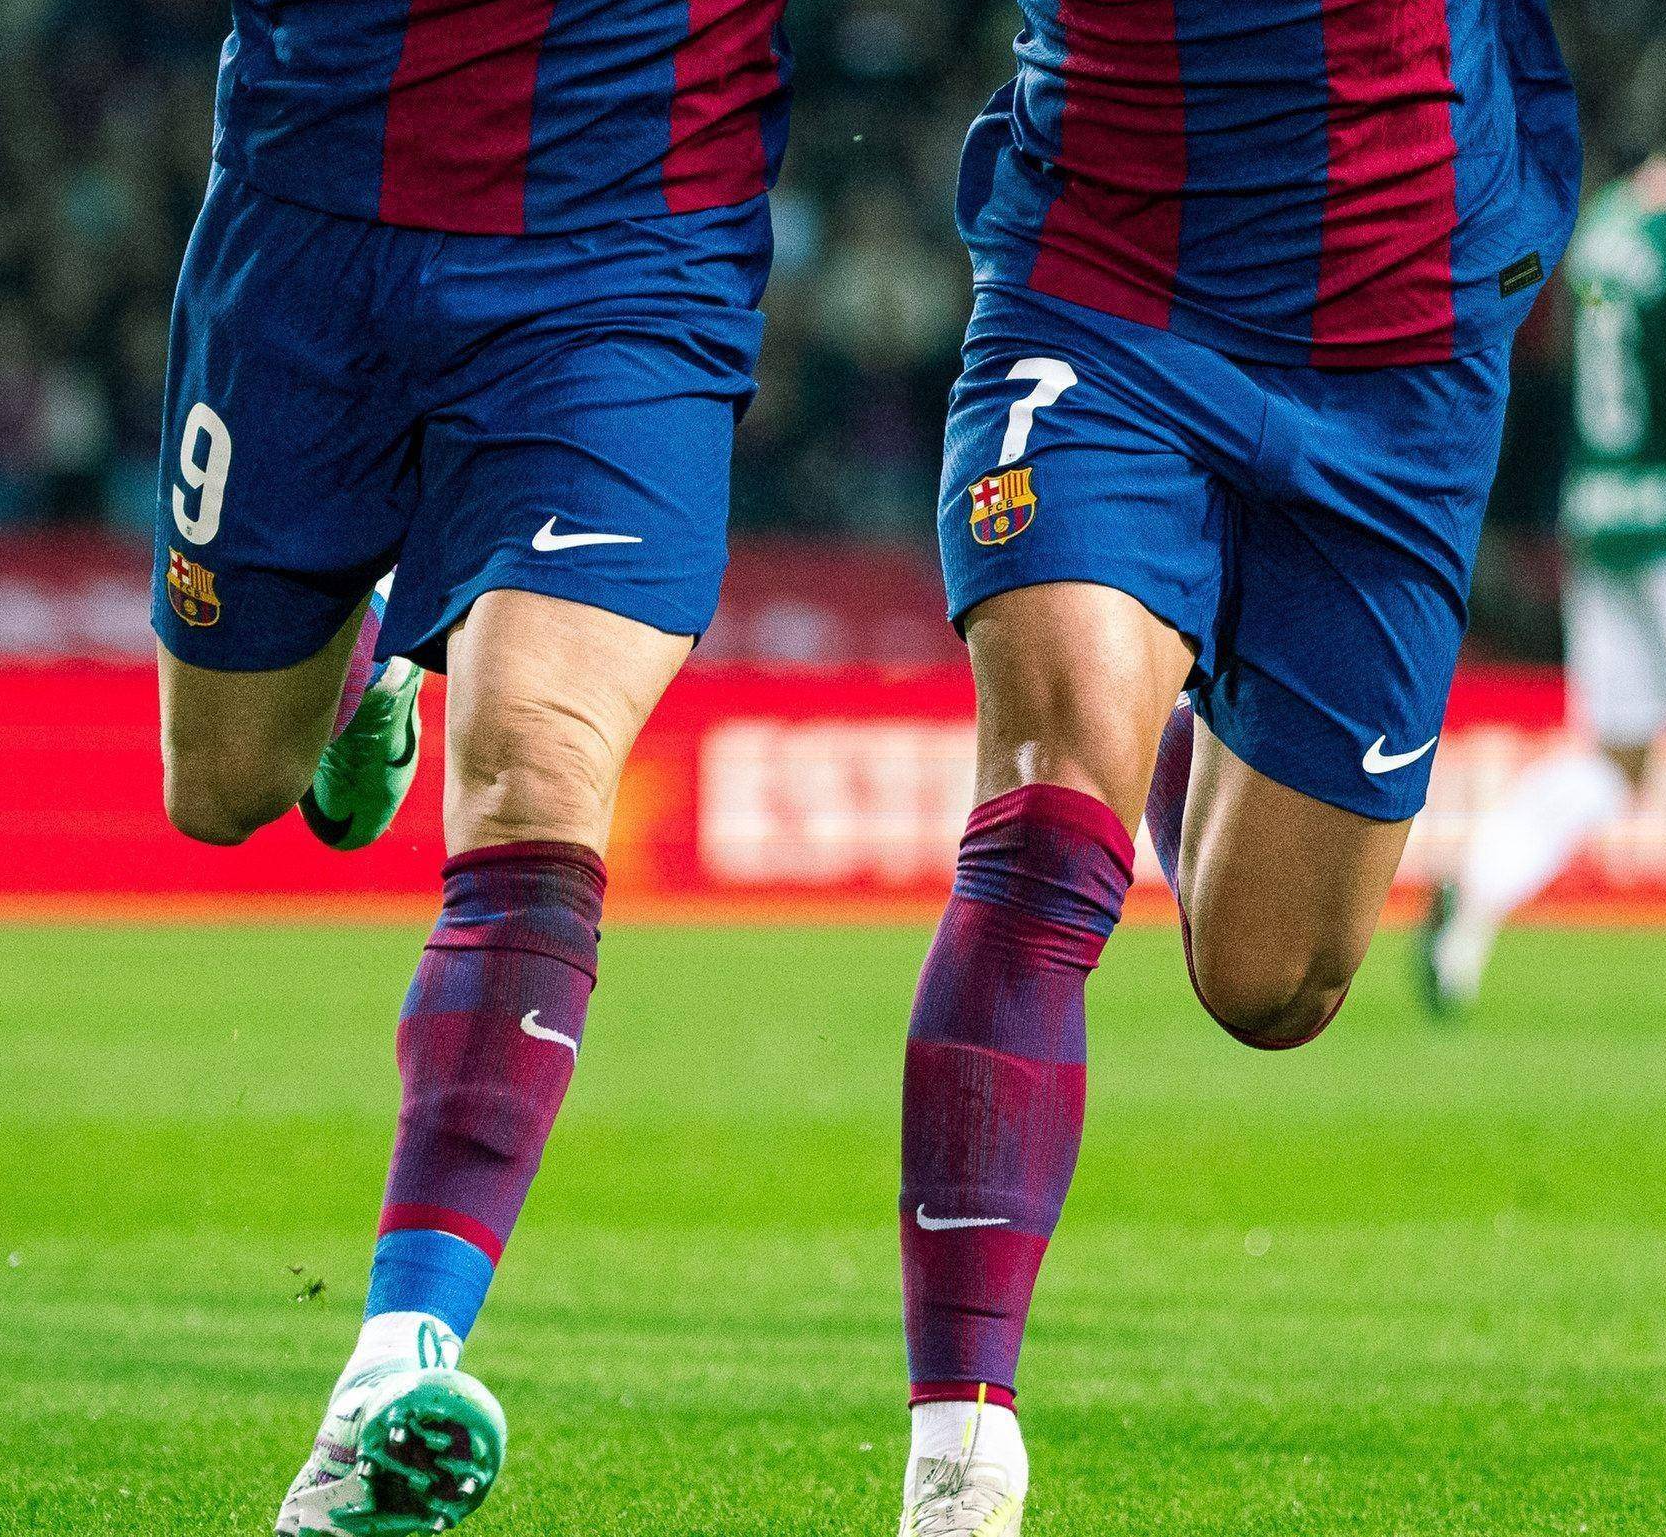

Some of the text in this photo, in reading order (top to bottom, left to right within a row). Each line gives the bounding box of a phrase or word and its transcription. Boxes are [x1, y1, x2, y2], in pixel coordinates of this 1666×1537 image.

[997, 357, 1079, 467] 7
[172, 402, 232, 545] 9
[987, 499, 1013, 516] FCB
